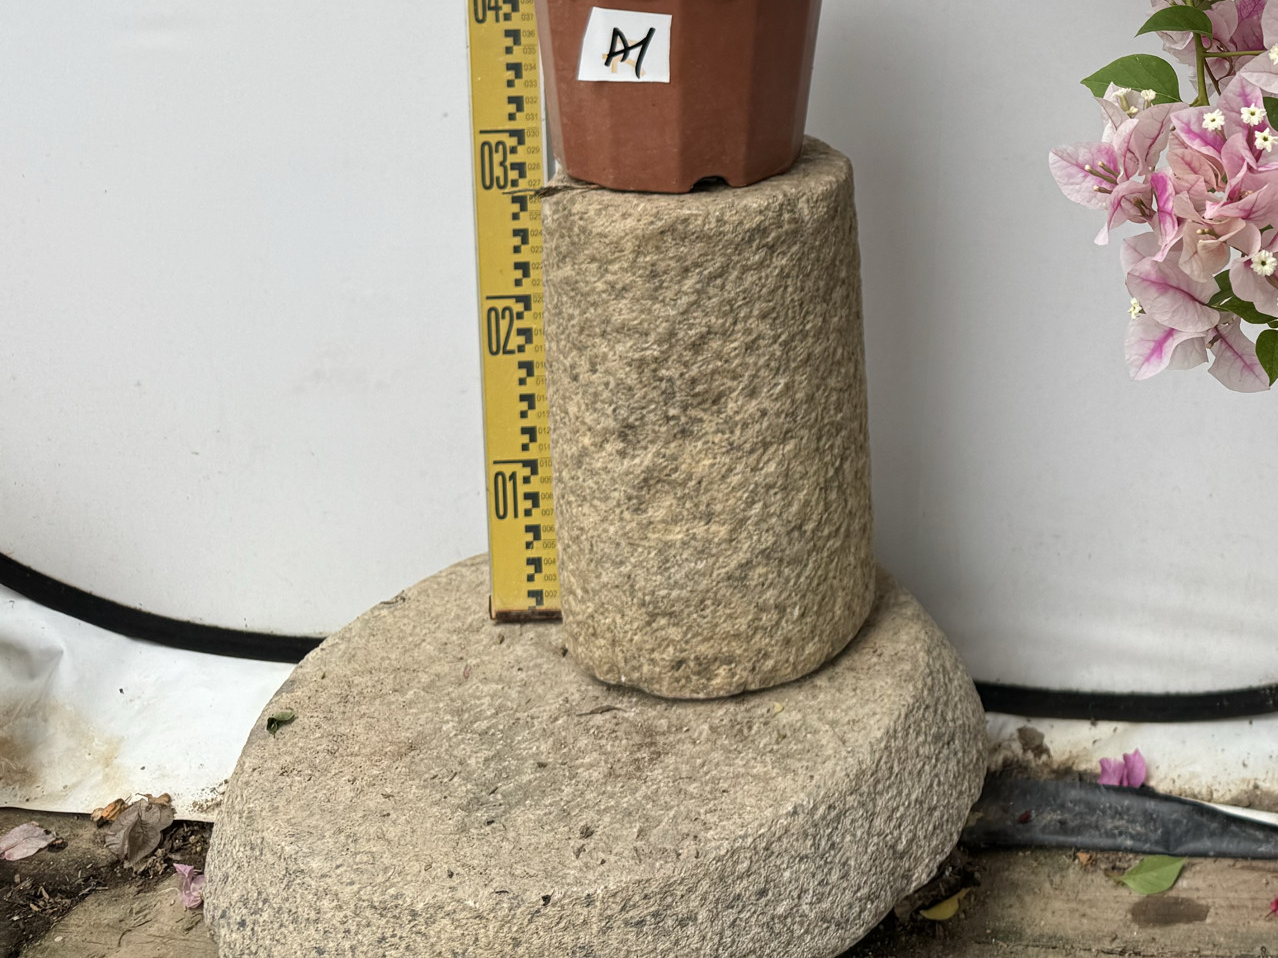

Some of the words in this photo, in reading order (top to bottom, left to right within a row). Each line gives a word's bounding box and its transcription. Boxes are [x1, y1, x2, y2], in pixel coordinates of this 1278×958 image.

[481, 140, 508, 190] 03
[487, 306, 515, 356] 02
[494, 471, 518, 520] 01
